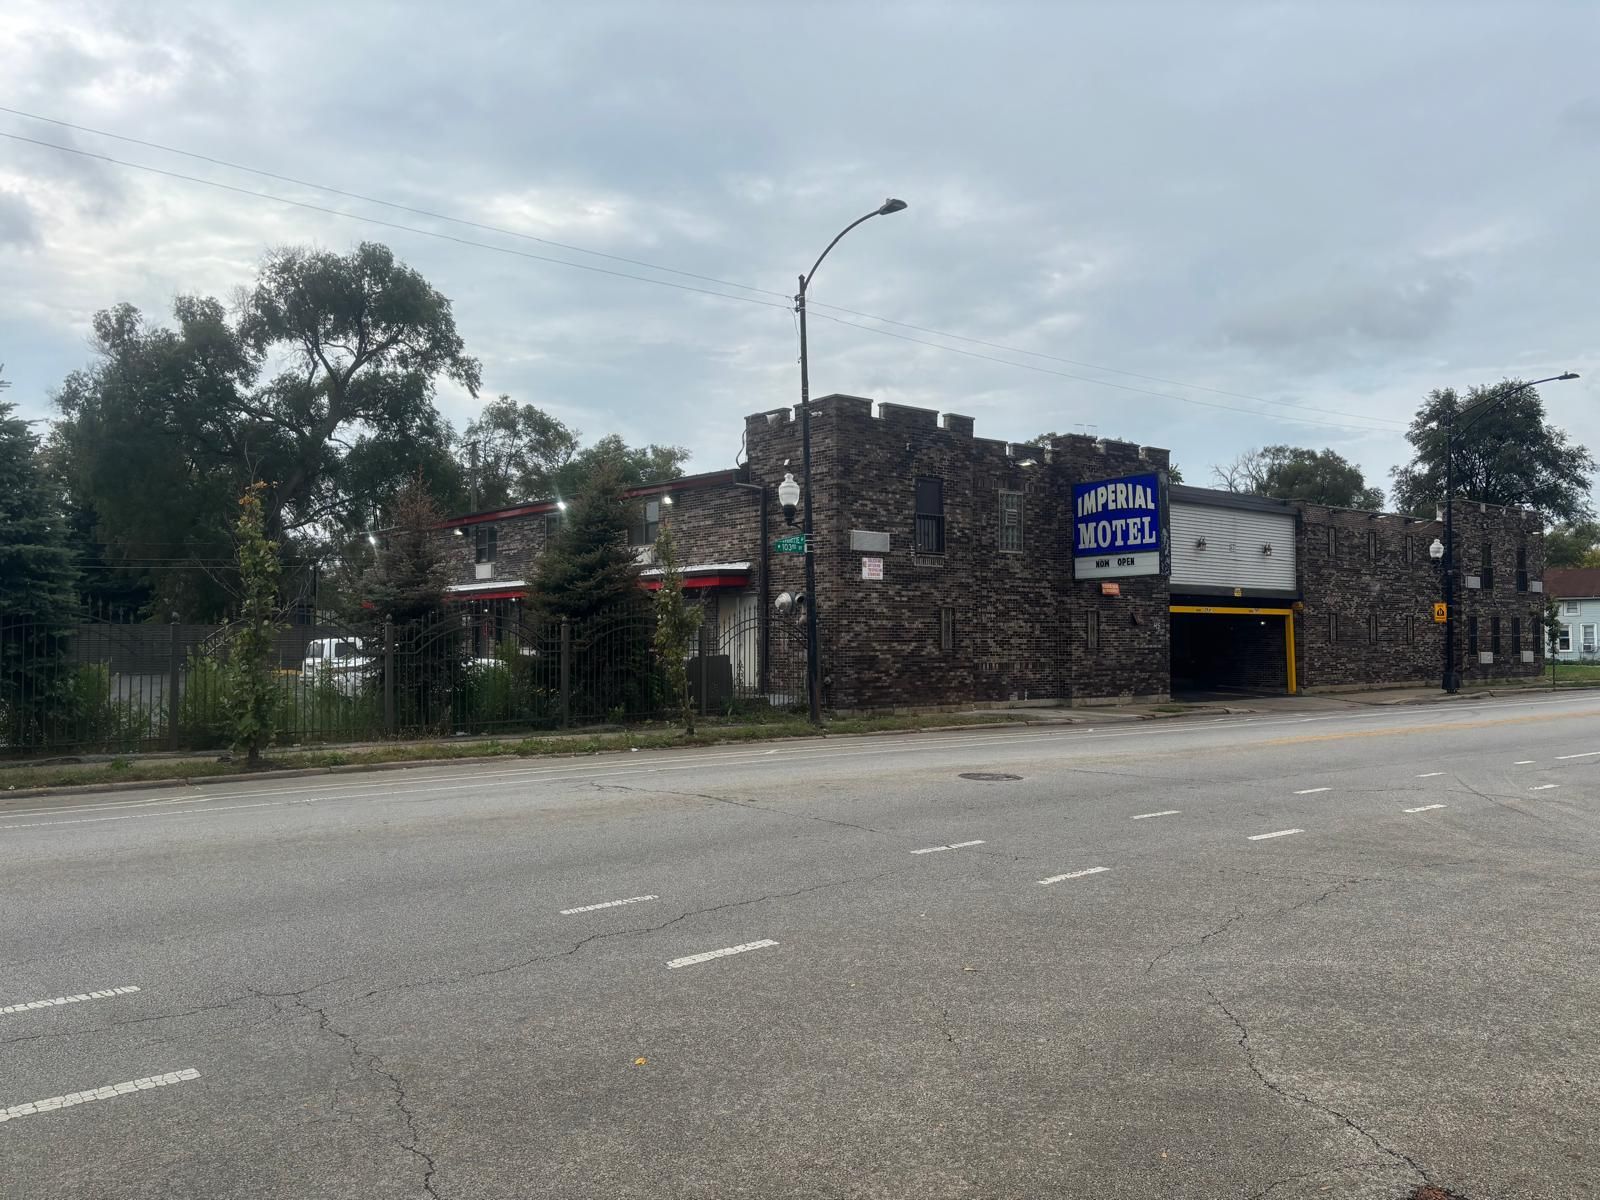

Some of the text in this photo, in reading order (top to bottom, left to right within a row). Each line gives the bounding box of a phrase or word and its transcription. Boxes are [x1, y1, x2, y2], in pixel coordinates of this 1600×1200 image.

[1077, 483, 1155, 517] IMPERIAL
[1077, 517, 1156, 549] MOTEL
[1117, 557, 1135, 567] OPEN
